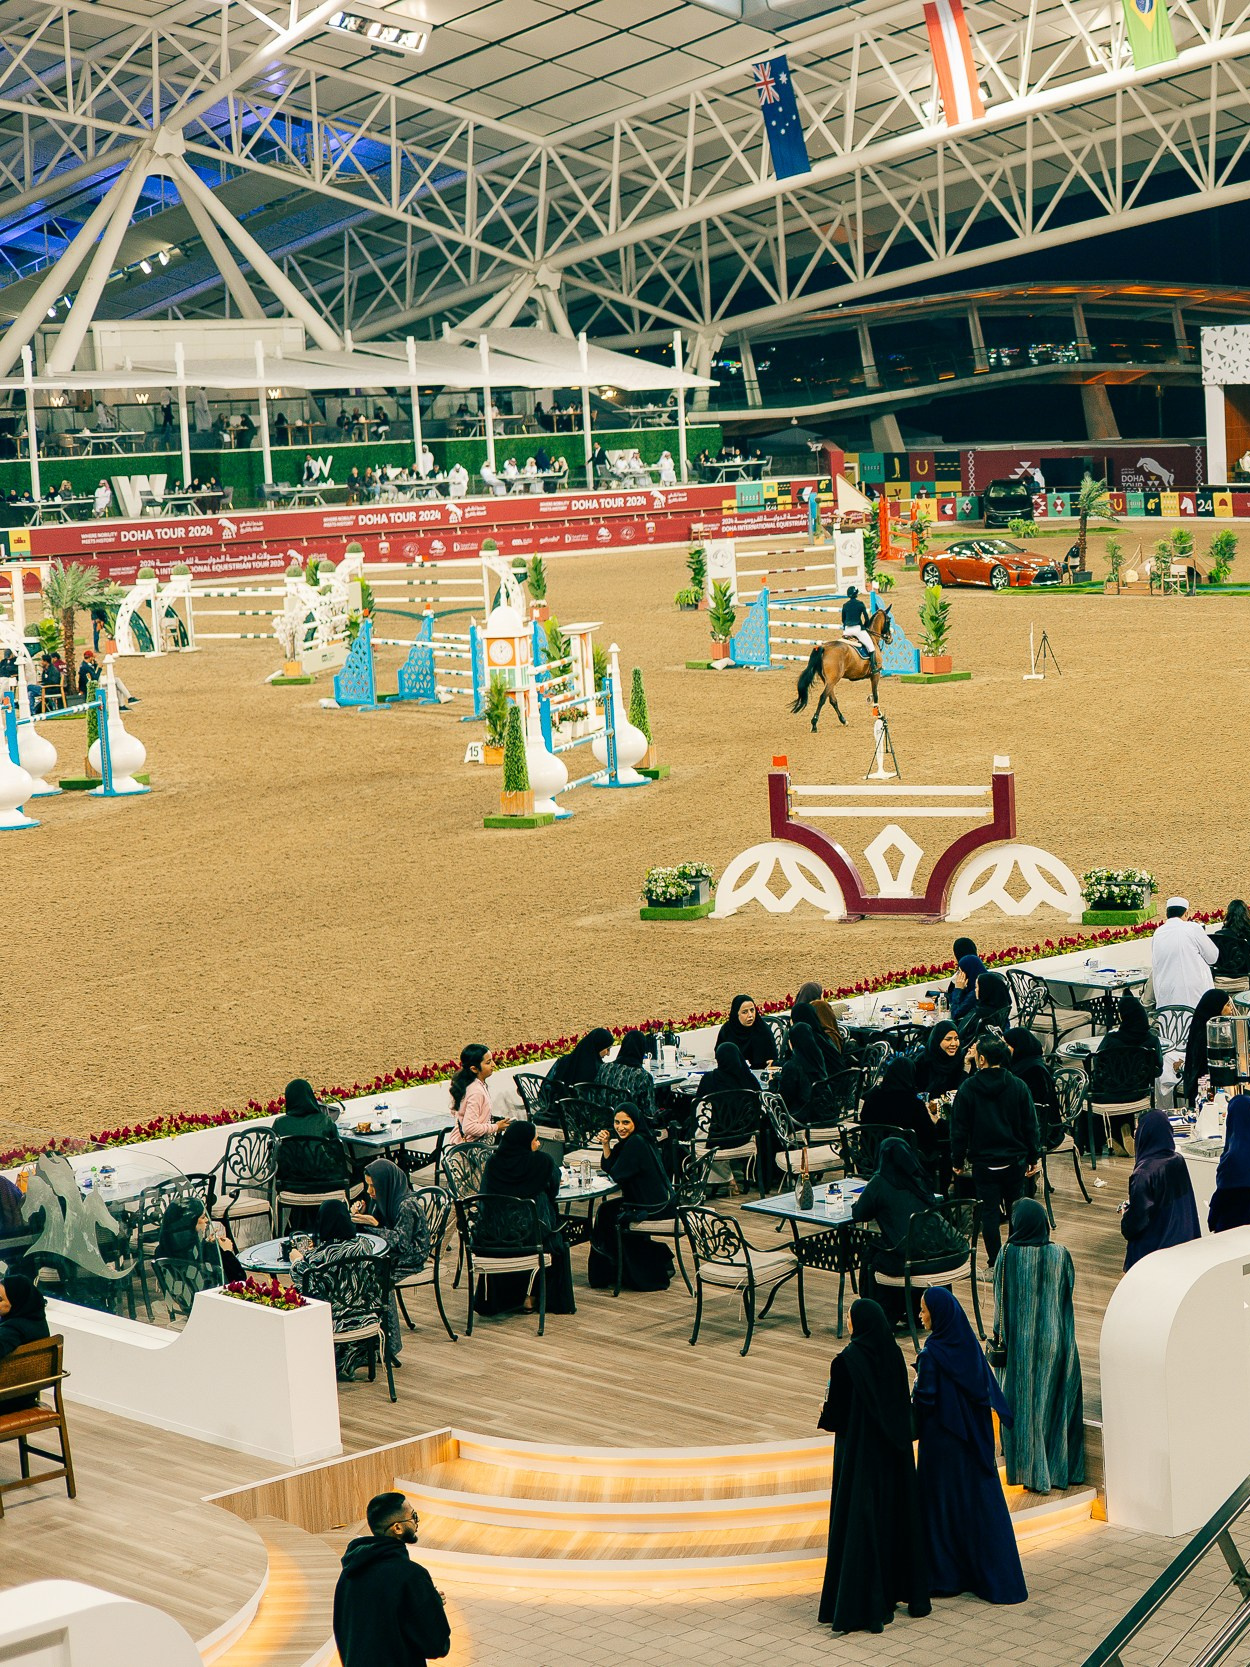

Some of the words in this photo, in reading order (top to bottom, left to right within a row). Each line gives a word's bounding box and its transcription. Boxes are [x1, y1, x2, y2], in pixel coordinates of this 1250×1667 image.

[136, 394, 149, 404] W
[268, 388, 280, 399] W
[50, 397, 64, 407] W
[572, 499, 599, 510] DOHA
[600, 498, 625, 509] TOUR
[626, 496, 646, 506] 2024
[1198, 500, 1212, 512] 24
[358, 513, 388, 526] DOHA
[389, 512, 416, 524] TOUR
[419, 510, 441, 522] 2024
[120, 529, 154, 542] DOHA
[155, 527, 185, 540] TOUR
[188, 525, 213, 537] 2024
[469, 746, 479, 757] 15
